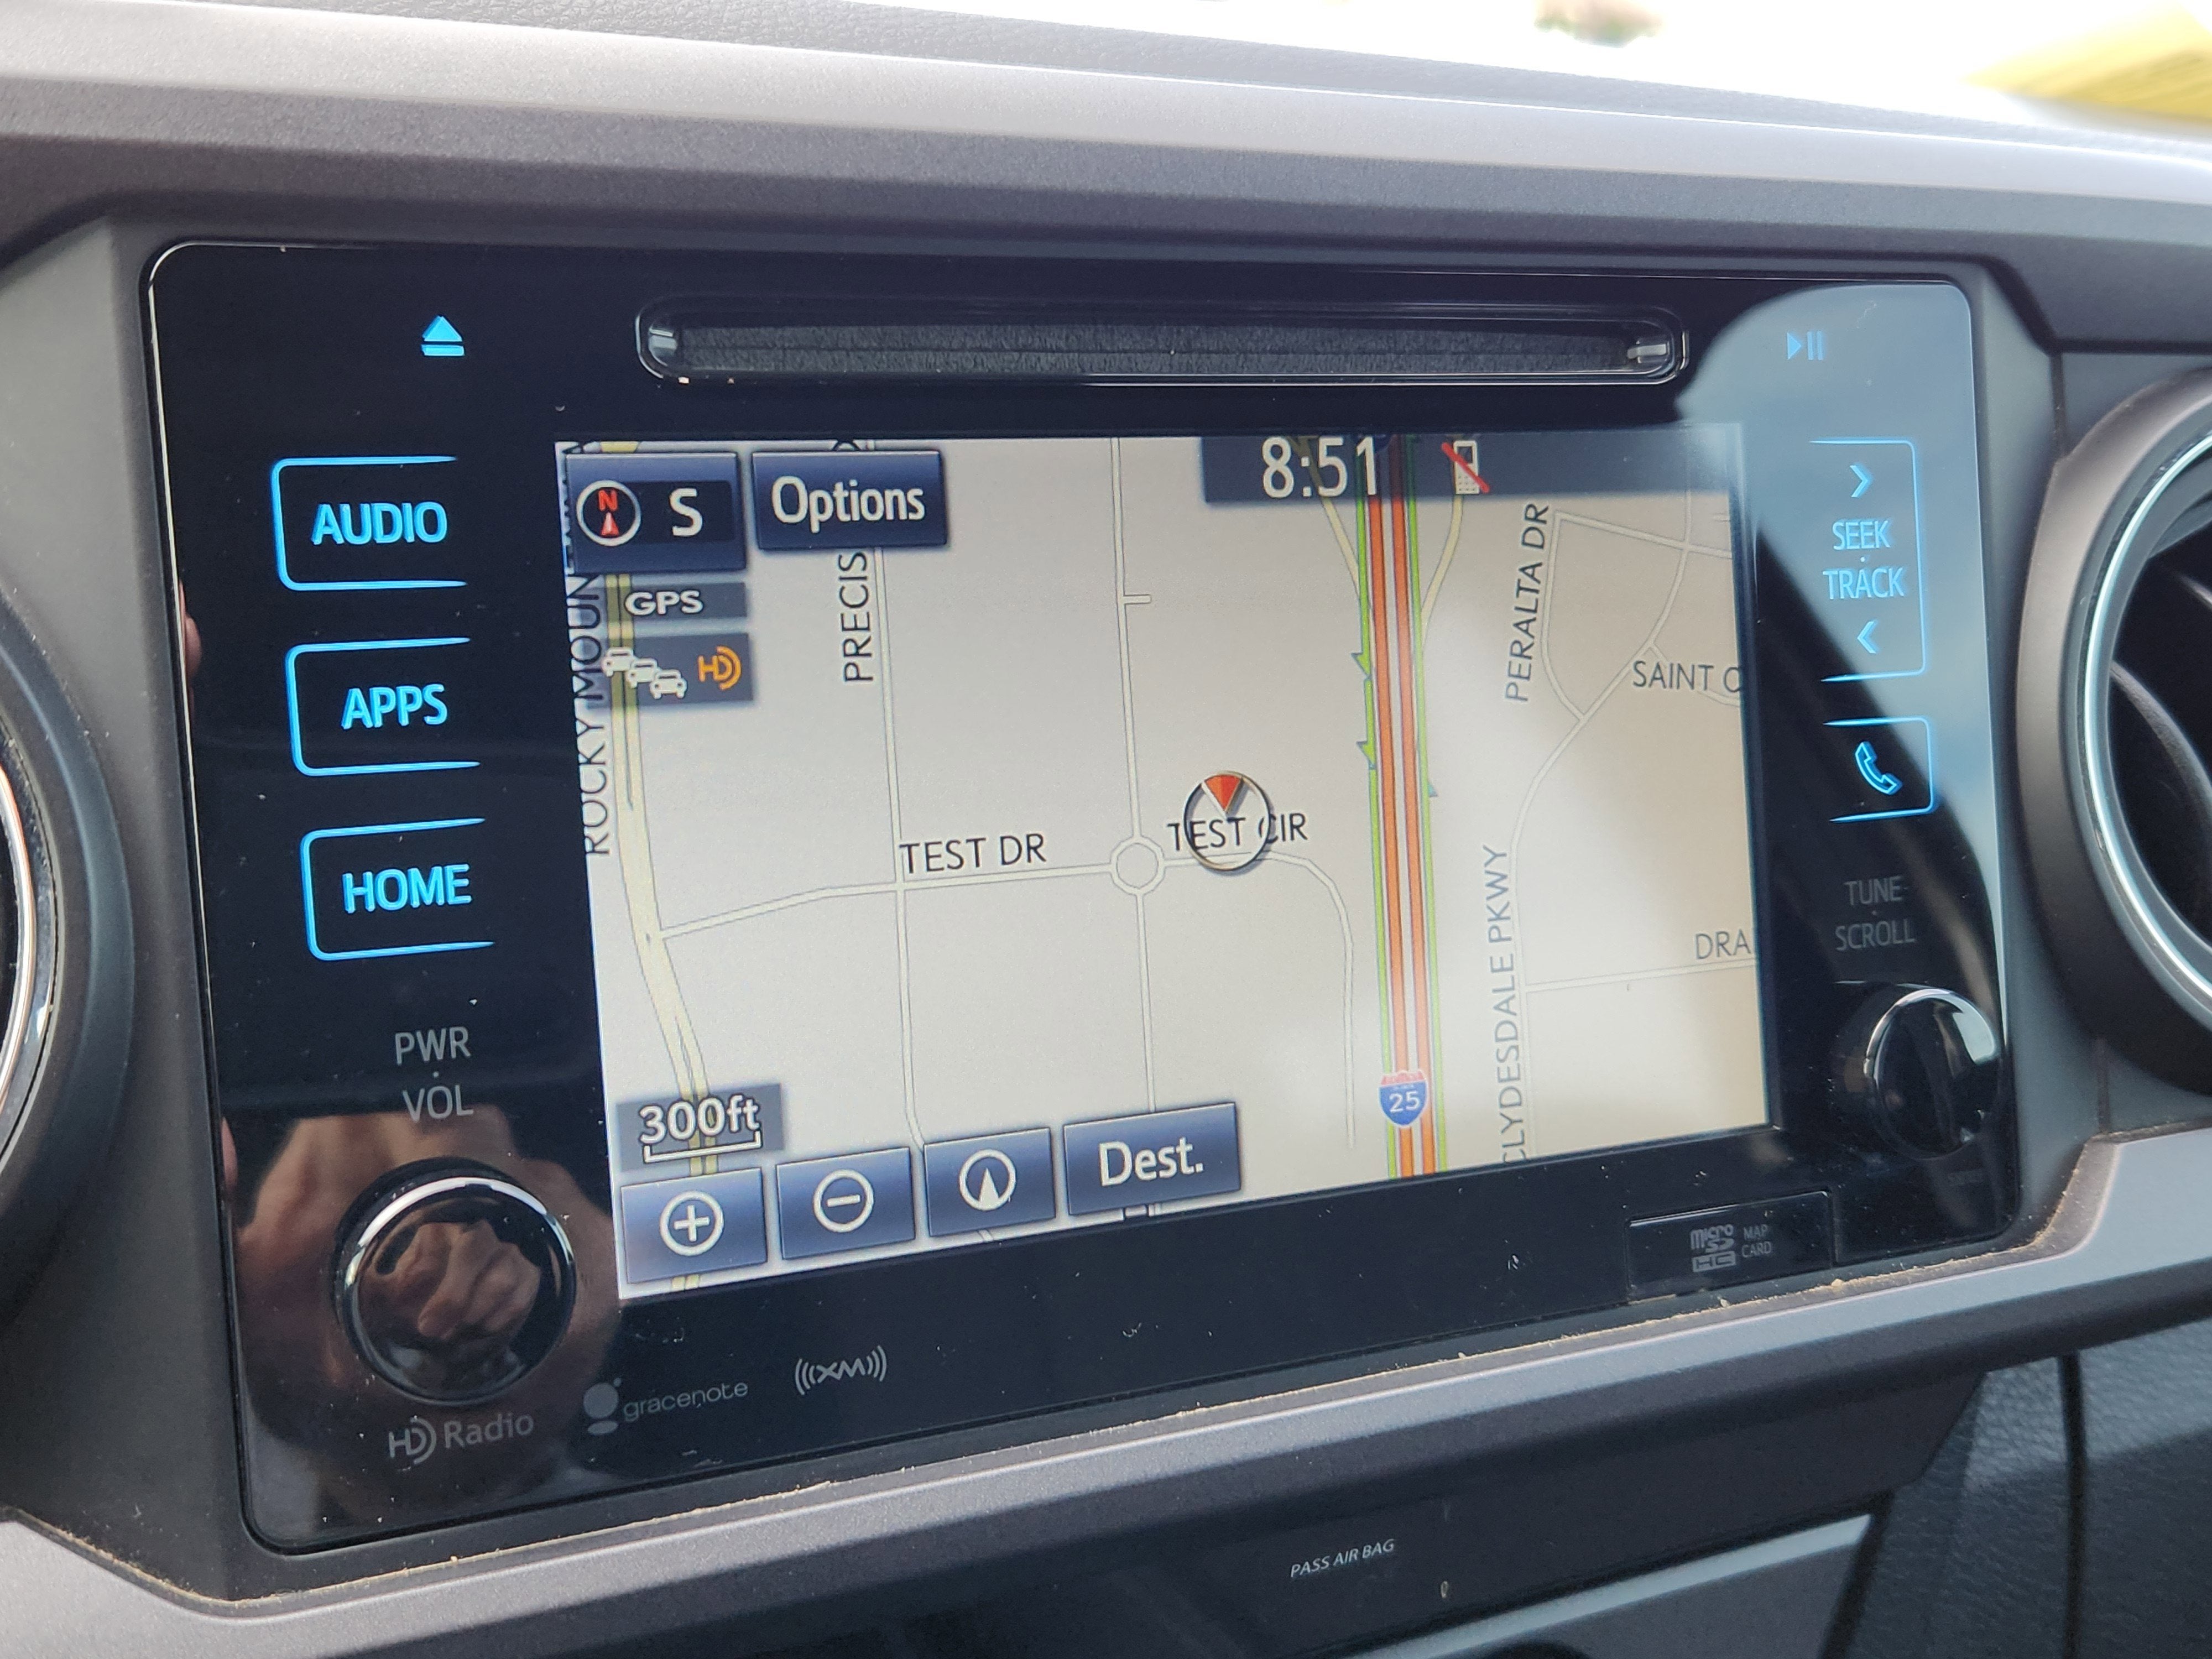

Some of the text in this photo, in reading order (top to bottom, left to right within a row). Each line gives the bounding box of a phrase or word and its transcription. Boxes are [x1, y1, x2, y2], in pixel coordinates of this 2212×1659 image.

[1262, 436, 1376, 498] 8:51
[598, 489, 618, 512] N
[669, 488, 703, 537] S
[772, 476, 926, 534] Options
[311, 502, 447, 545] AUDIO
[1832, 519, 1892, 551] SEEK
[624, 589, 703, 615] GPS
[1504, 503, 1549, 701] PERALTA DR
[1822, 567, 1906, 599] TRACK
[838, 551, 874, 682] PRECIS
[1632, 660, 1714, 691] SAINT
[341, 684, 448, 730] APPS
[576, 718, 610, 854] ROCKY
[1167, 812, 1308, 851] TEST CIR
[899, 833, 1047, 874] TEST DR
[342, 863, 472, 914] HOME
[1483, 844, 1514, 944] PKWY
[1843, 875, 1903, 906] TUNE
[1695, 928, 1751, 960] DRA
[1835, 918, 1916, 952] SCROLL
[394, 1026, 471, 1065] PWR
[403, 1084, 474, 1123] VOL
[638, 1093, 762, 1145] 300ft
[1389, 1091, 1420, 1113] 25
[1098, 1136, 1204, 1187] Dest.
[1742, 1240, 1772, 1258] CARD
[1743, 1224, 1768, 1240] MAP
[623, 1383, 749, 1422] gracenote
[444, 1412, 534, 1449] Radio
[1290, 1538, 1395, 1578] PASS AIR BAG
